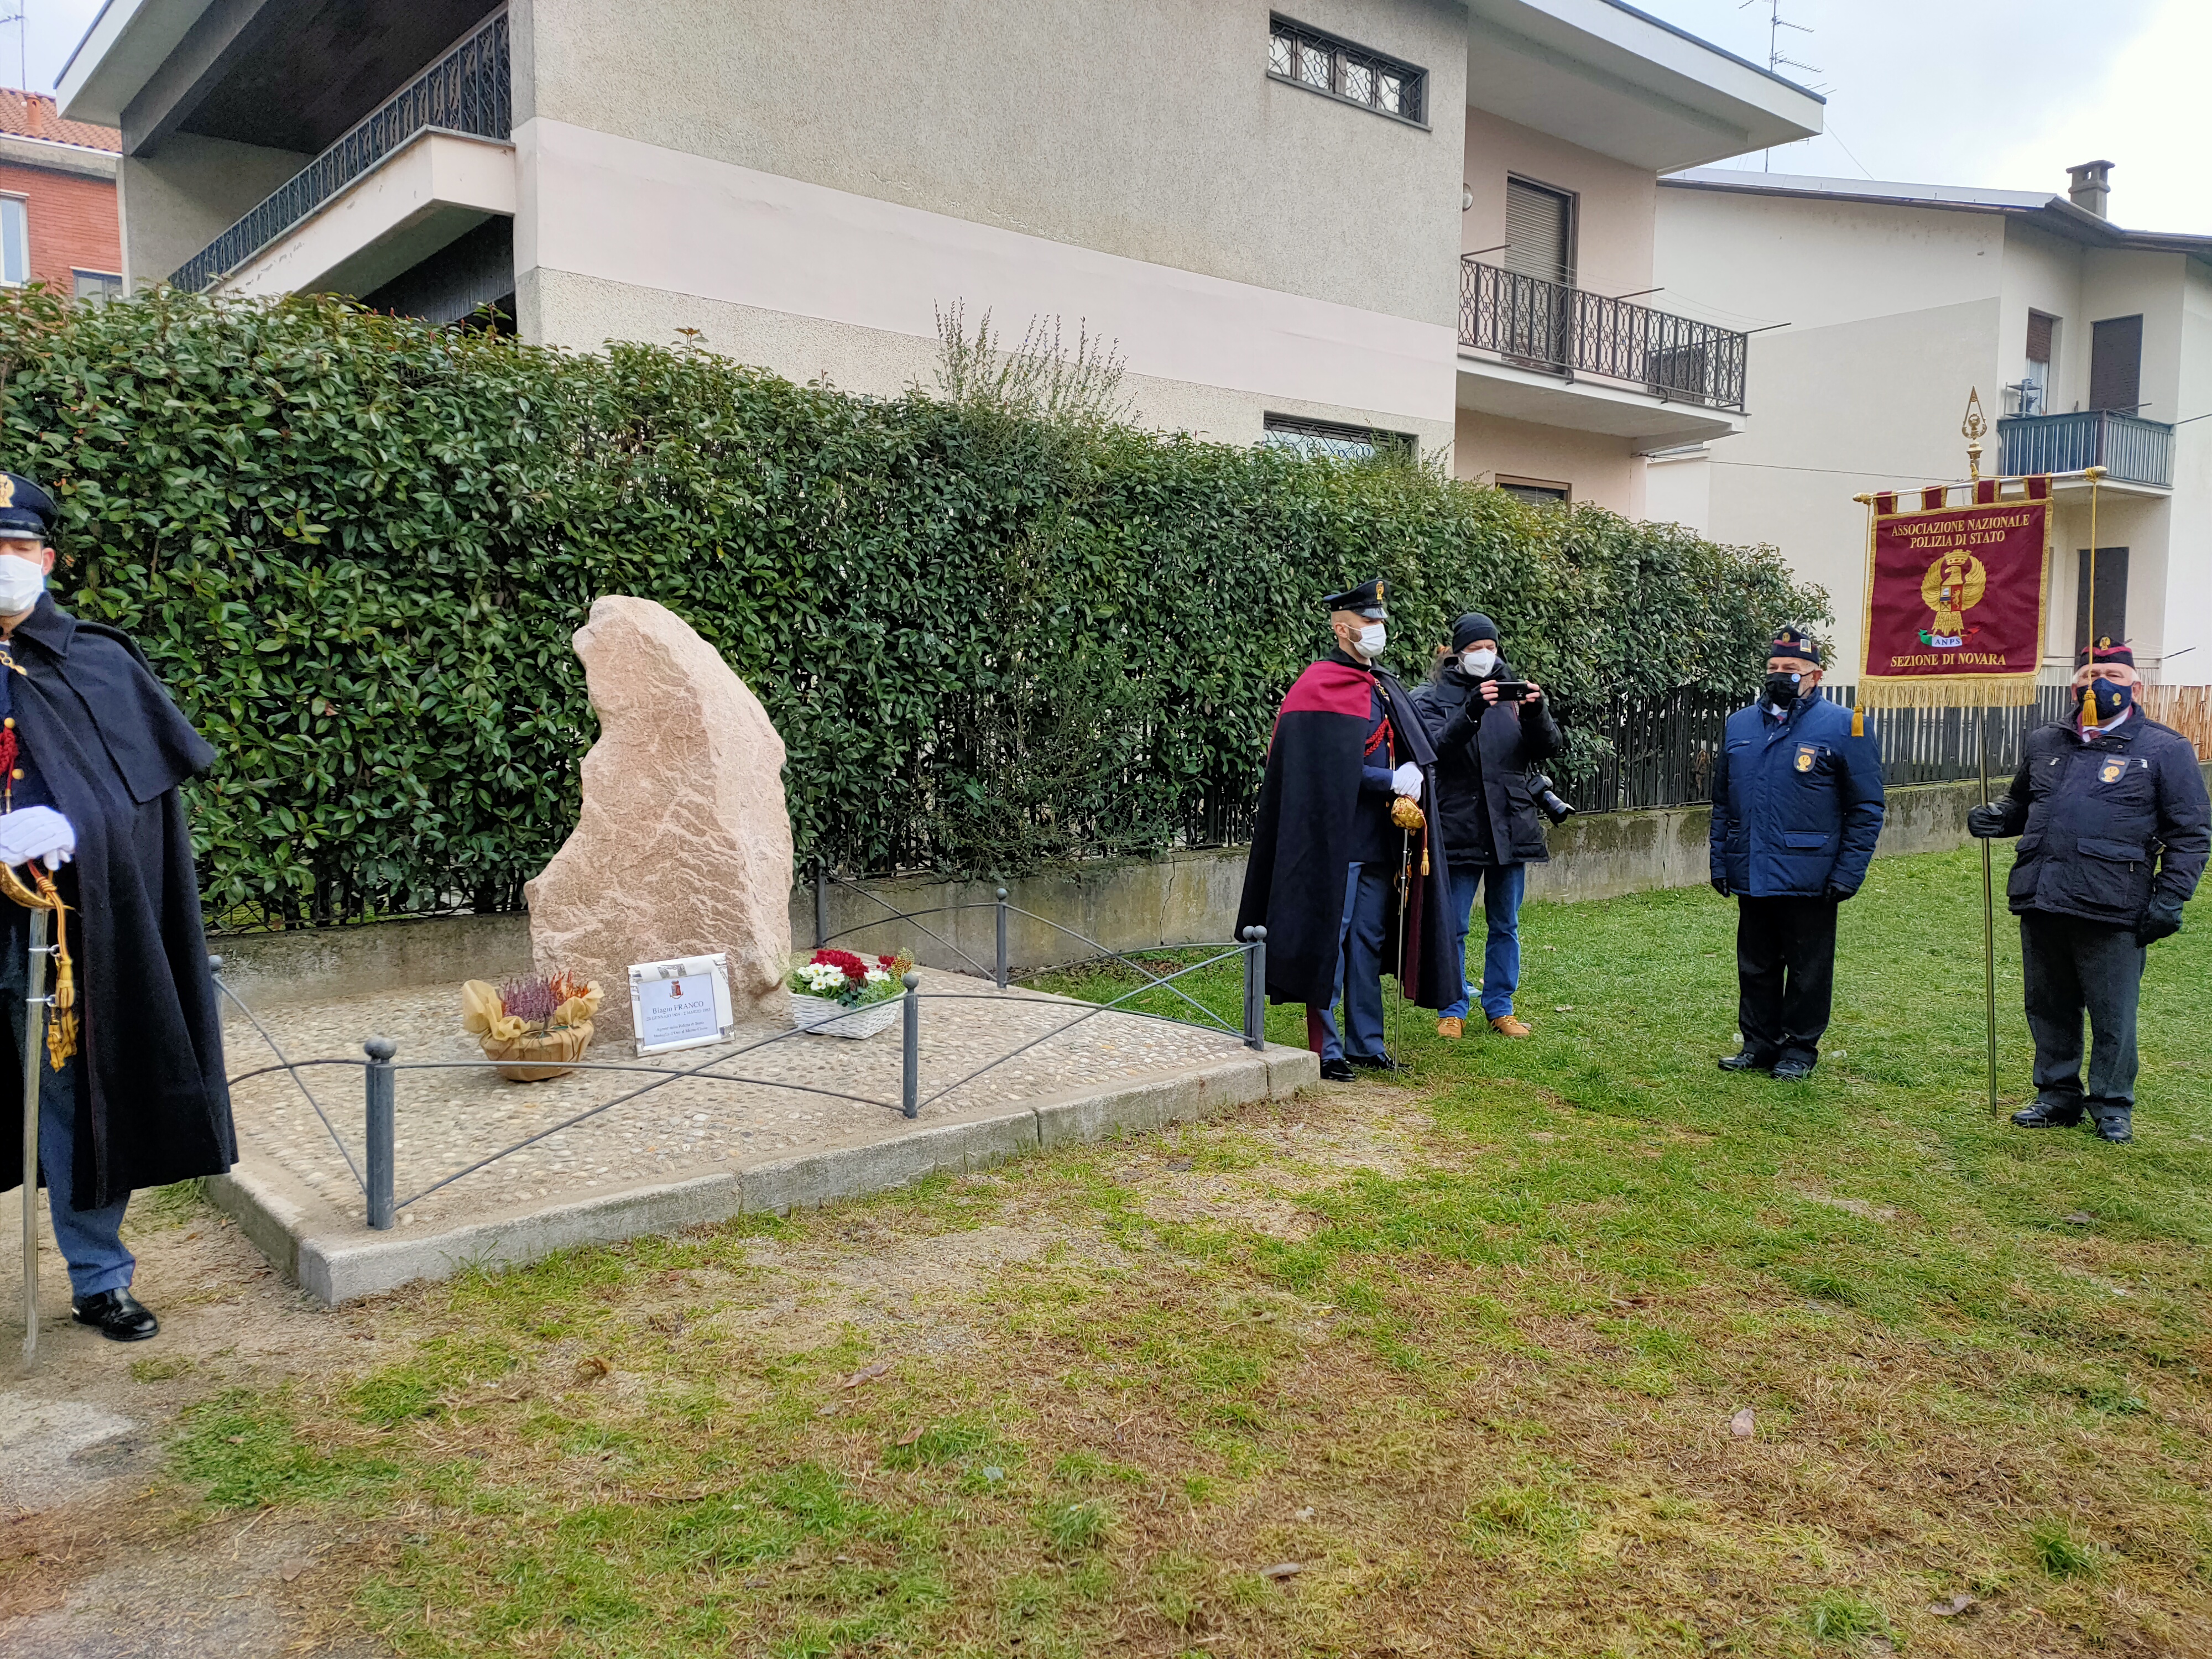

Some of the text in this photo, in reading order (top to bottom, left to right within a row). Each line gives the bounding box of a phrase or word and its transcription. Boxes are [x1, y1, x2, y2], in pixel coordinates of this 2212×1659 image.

[1891, 514, 2030, 537] ASSOCIAZIONE NAZIONALE
[1910, 530, 2005, 549] POLIZIA DI STATO
[1890, 653, 2006, 667] SEZIONE DI NOVARA
[653, 1000, 704, 1014] Biagio FRANCO
